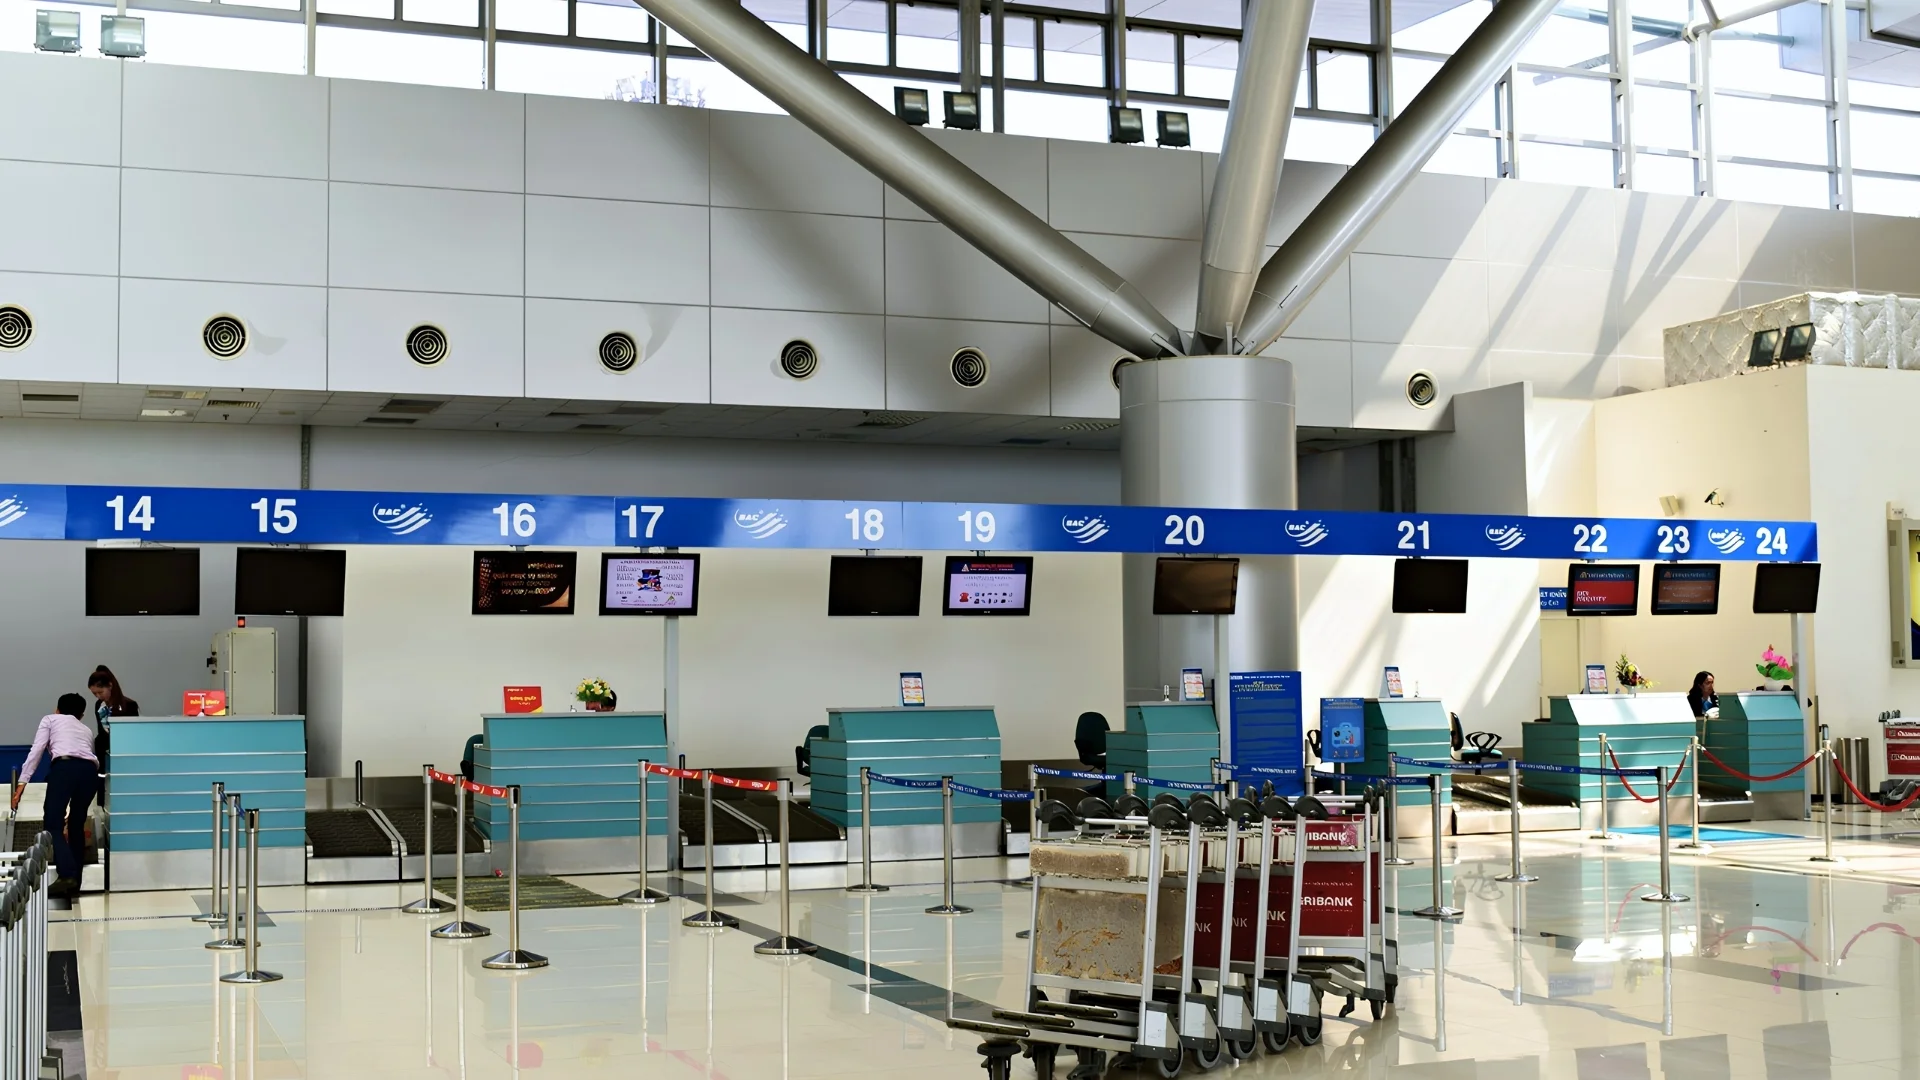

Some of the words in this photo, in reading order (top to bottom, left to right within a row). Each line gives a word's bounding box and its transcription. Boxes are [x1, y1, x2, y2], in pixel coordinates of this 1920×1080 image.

[106, 495, 155, 531] 14
[251, 497, 297, 534] 15
[493, 502, 536, 537] 16
[622, 505, 664, 538] 17
[845, 508, 884, 541] 18
[958, 510, 996, 543] 19
[1165, 515, 1204, 546] 20
[1398, 520, 1429, 550] 21
[1573, 524, 1608, 553] 22
[1657, 525, 1690, 554] 23
[1756, 527, 1788, 555] 24
